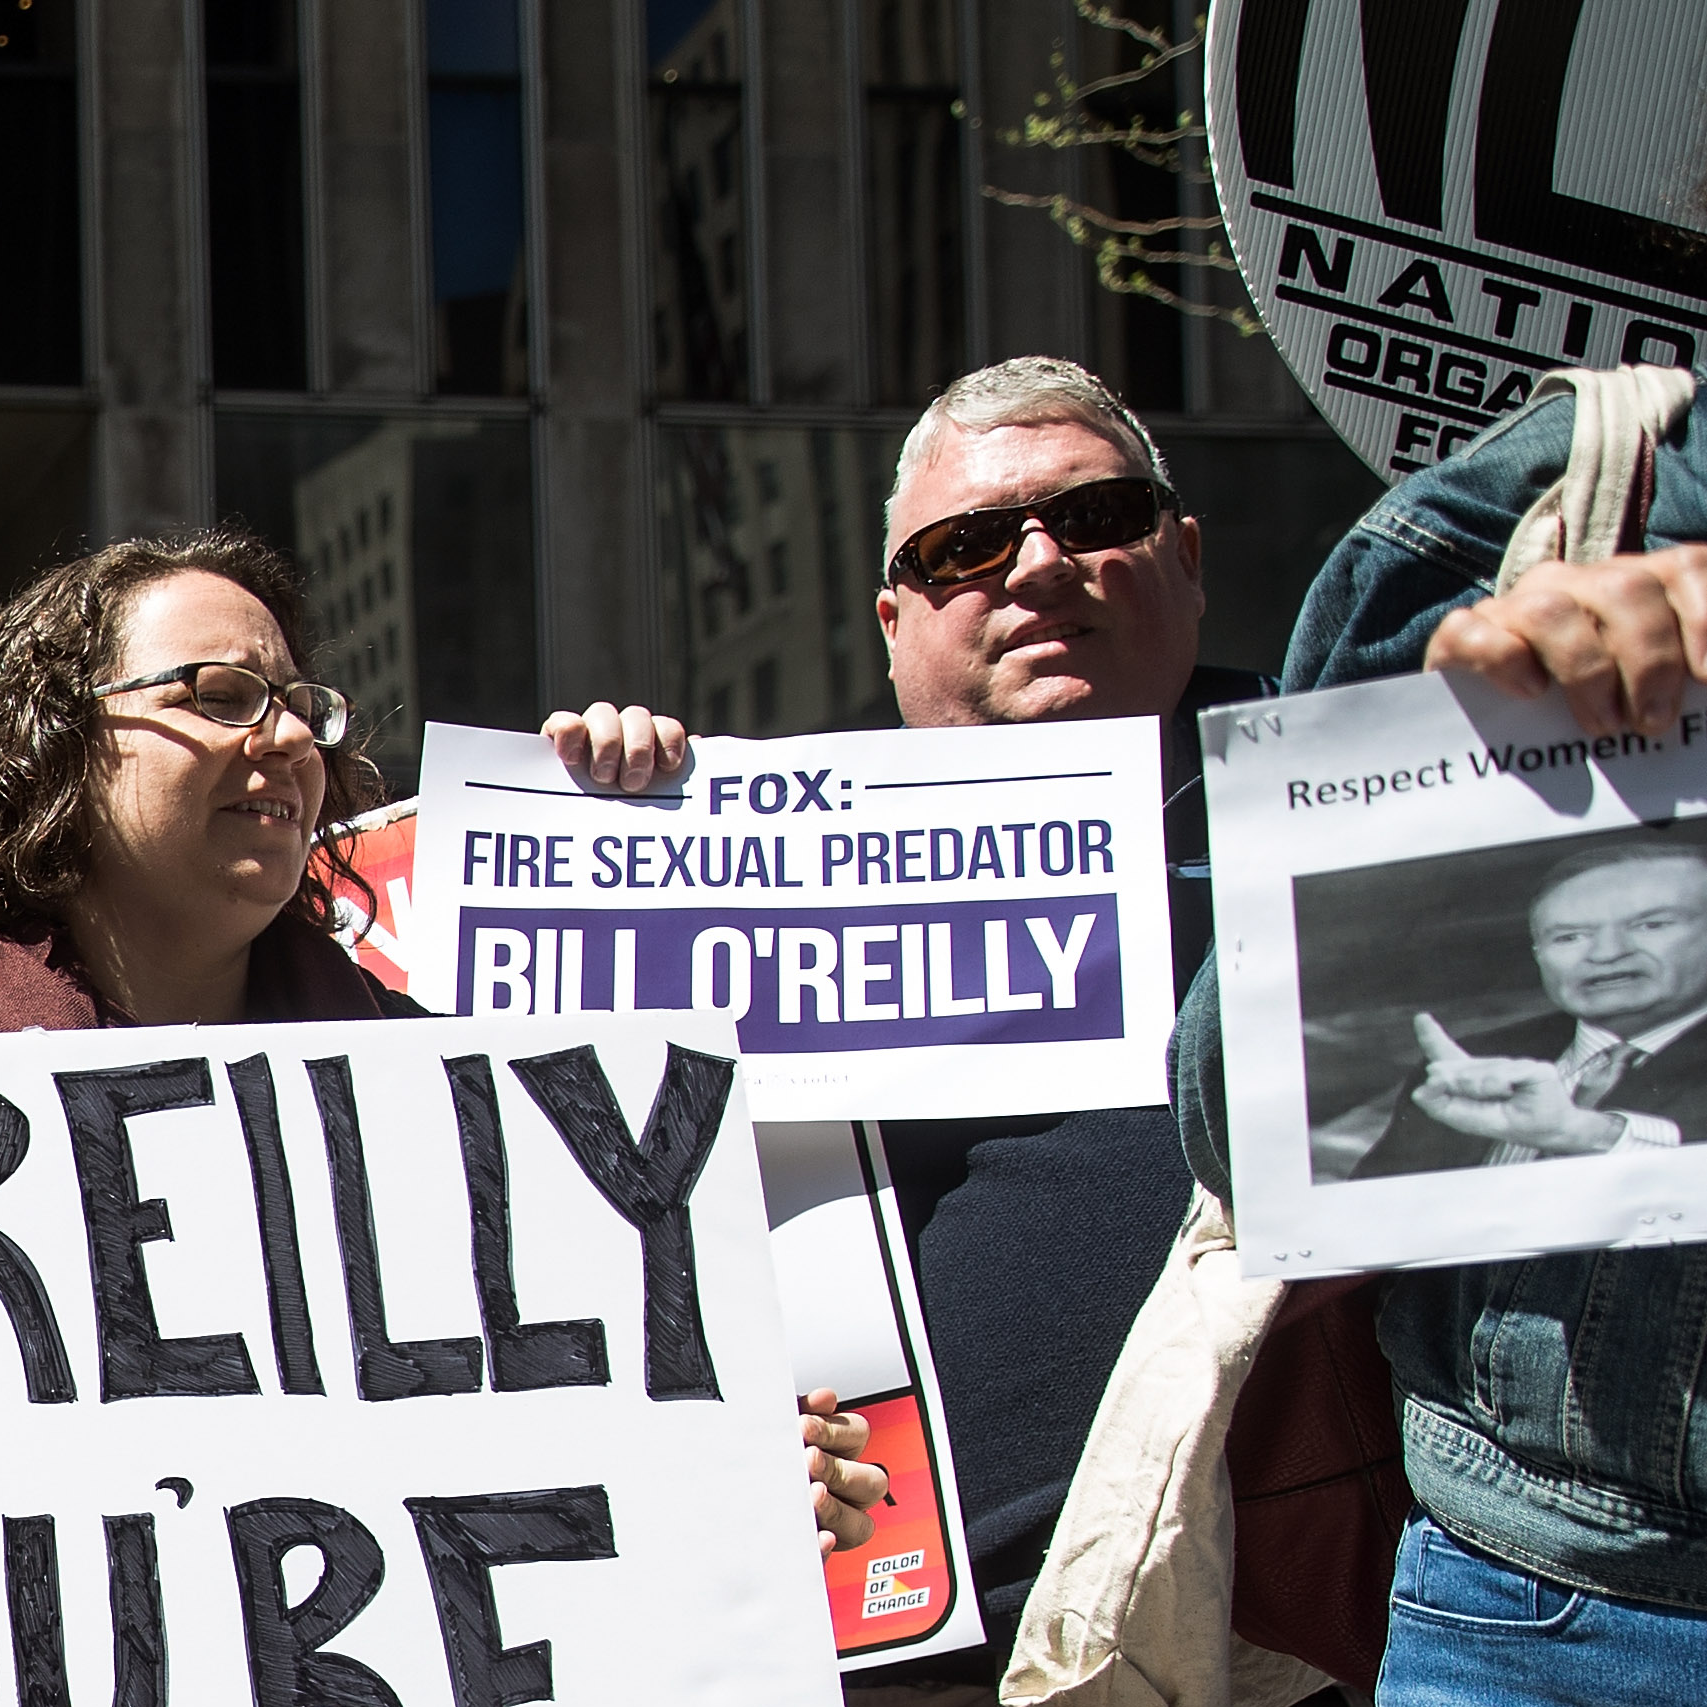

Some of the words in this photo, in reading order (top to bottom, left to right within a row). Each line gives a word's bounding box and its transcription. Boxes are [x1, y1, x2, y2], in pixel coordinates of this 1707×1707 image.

[709, 769, 853, 815] FOX:
[1288, 757, 1454, 810] Respect
[1468, 731, 1662, 778] Women.
[463, 830, 574, 888] FIRE
[592, 834, 802, 888] SEXUAL
[822, 819, 1114, 887] PREDATOR
[473, 928, 639, 1016] BILL
[691, 914, 1097, 1024] O'REILLY
[869, 1579, 888, 1594] OF
[872, 1552, 920, 1575] COLOR
[867, 1591, 925, 1614] CHANGE
